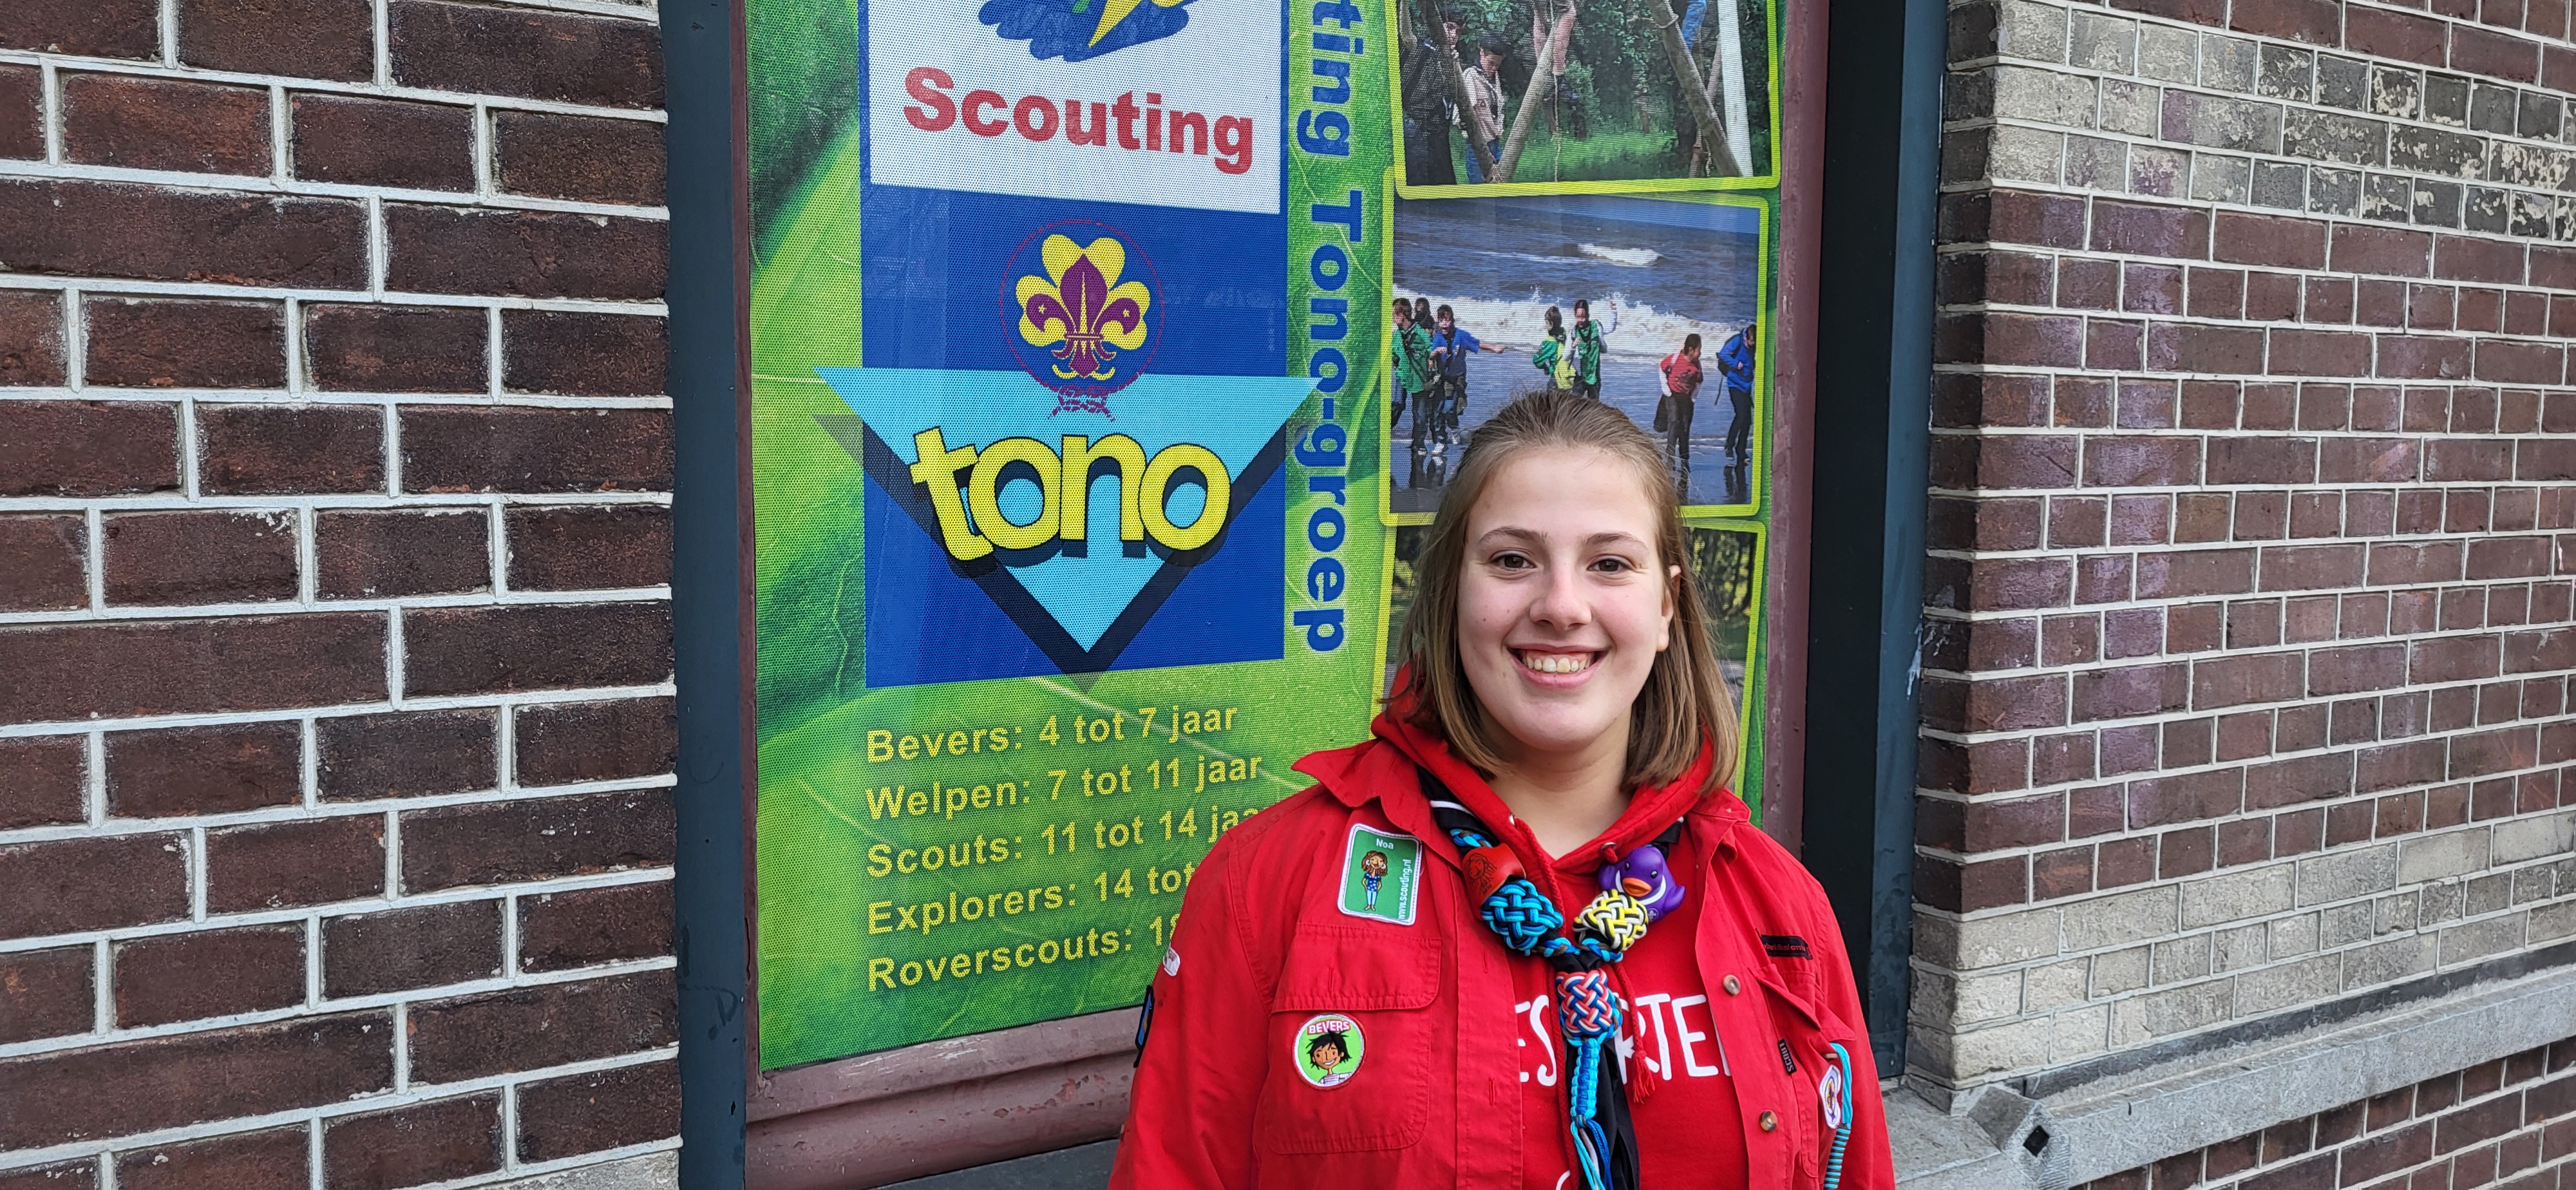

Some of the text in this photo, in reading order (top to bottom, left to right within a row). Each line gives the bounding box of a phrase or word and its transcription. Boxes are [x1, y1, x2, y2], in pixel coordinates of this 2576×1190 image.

[904, 66, 1253, 175] Scouting
[1293, 190, 1363, 652] Tono-groep
[909, 426, 1231, 561] tono
[867, 704, 1238, 763] Bevers: 4 tot 7 jaar
[866, 755, 1262, 820] Welpen: 7 tot 11 jaar
[867, 805, 1269, 878] Scouts: 11 tot 14 ja
[1376, 838, 1394, 849] Noa
[868, 881, 1076, 935] Explorers:
[1094, 869, 1133, 901] 14
[1398, 859, 1412, 920] www.scouting.nl
[868, 926, 1132, 992] Roverscouts:
[1309, 1020, 1350, 1034] BEVERS
